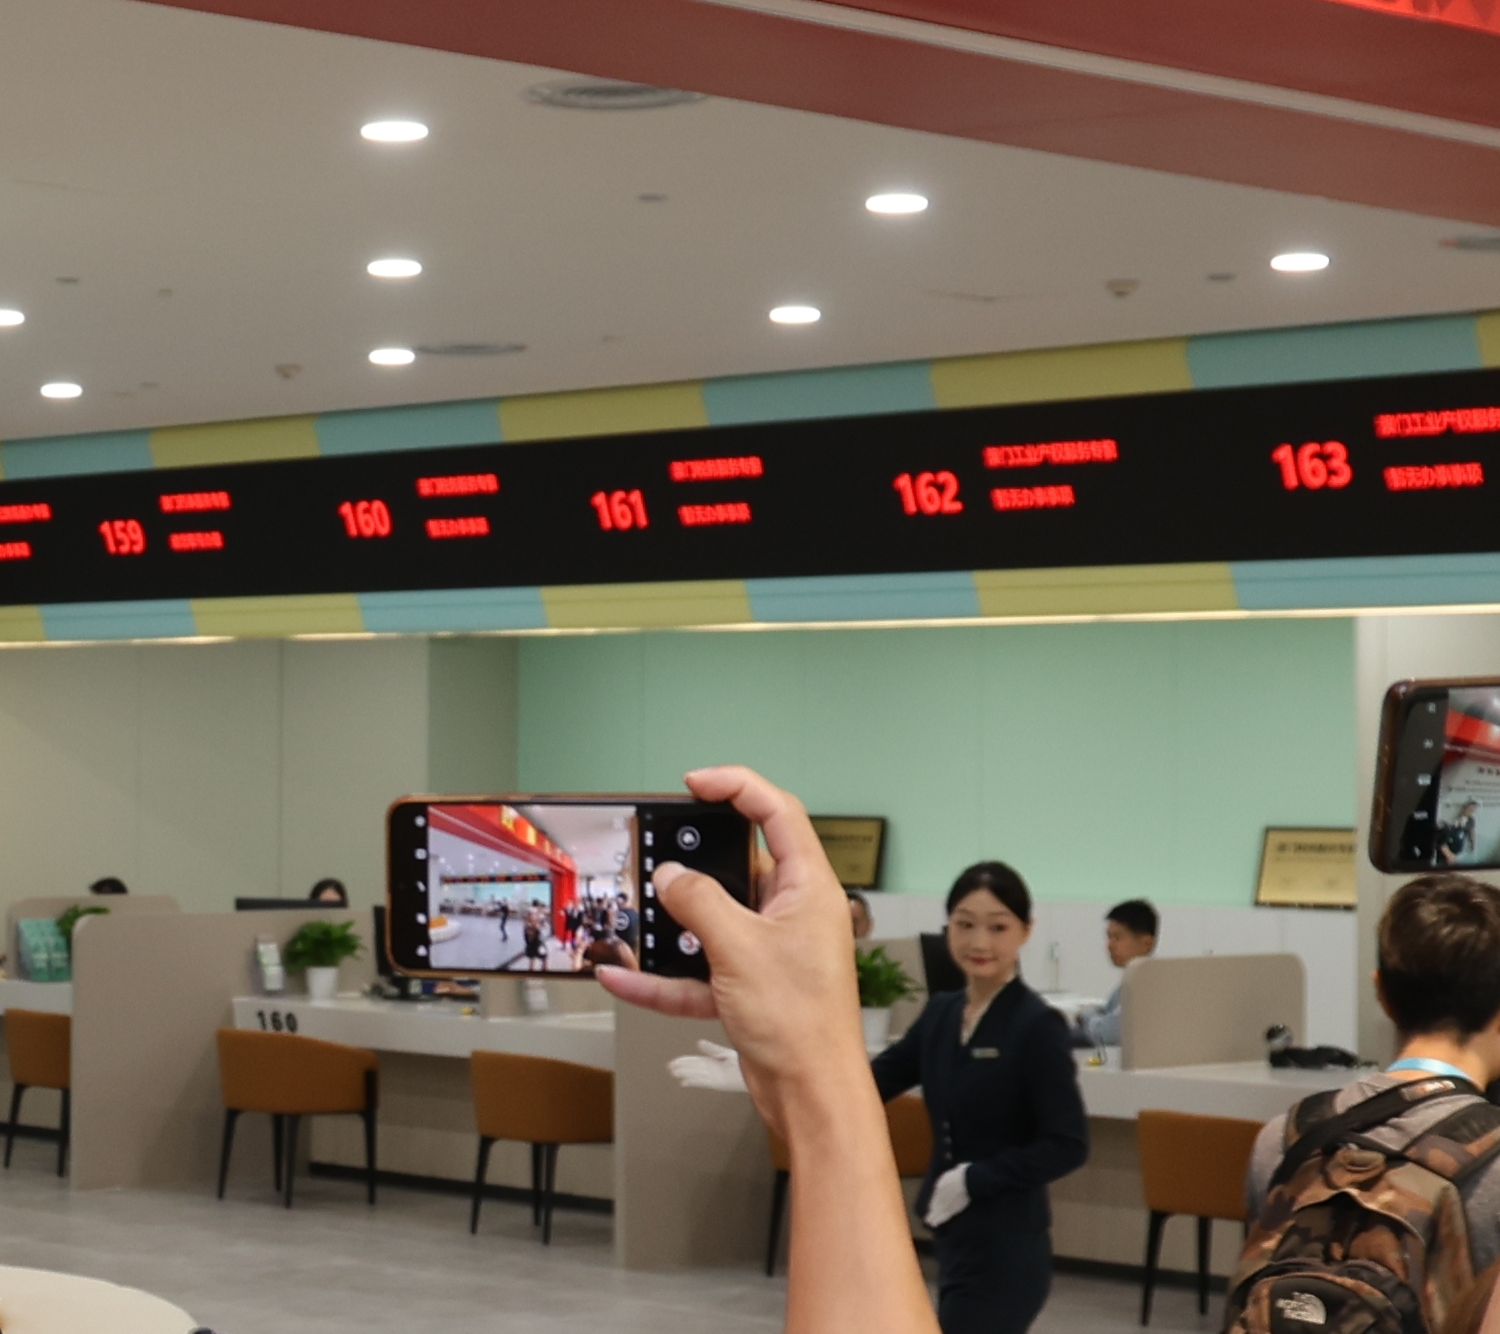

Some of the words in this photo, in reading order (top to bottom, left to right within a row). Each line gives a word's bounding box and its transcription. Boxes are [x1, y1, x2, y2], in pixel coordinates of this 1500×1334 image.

[1273, 441, 1352, 489] 163
[592, 490, 647, 529] 161
[895, 471, 962, 514] 162
[100, 520, 145, 554] 159
[340, 500, 391, 537] 160
